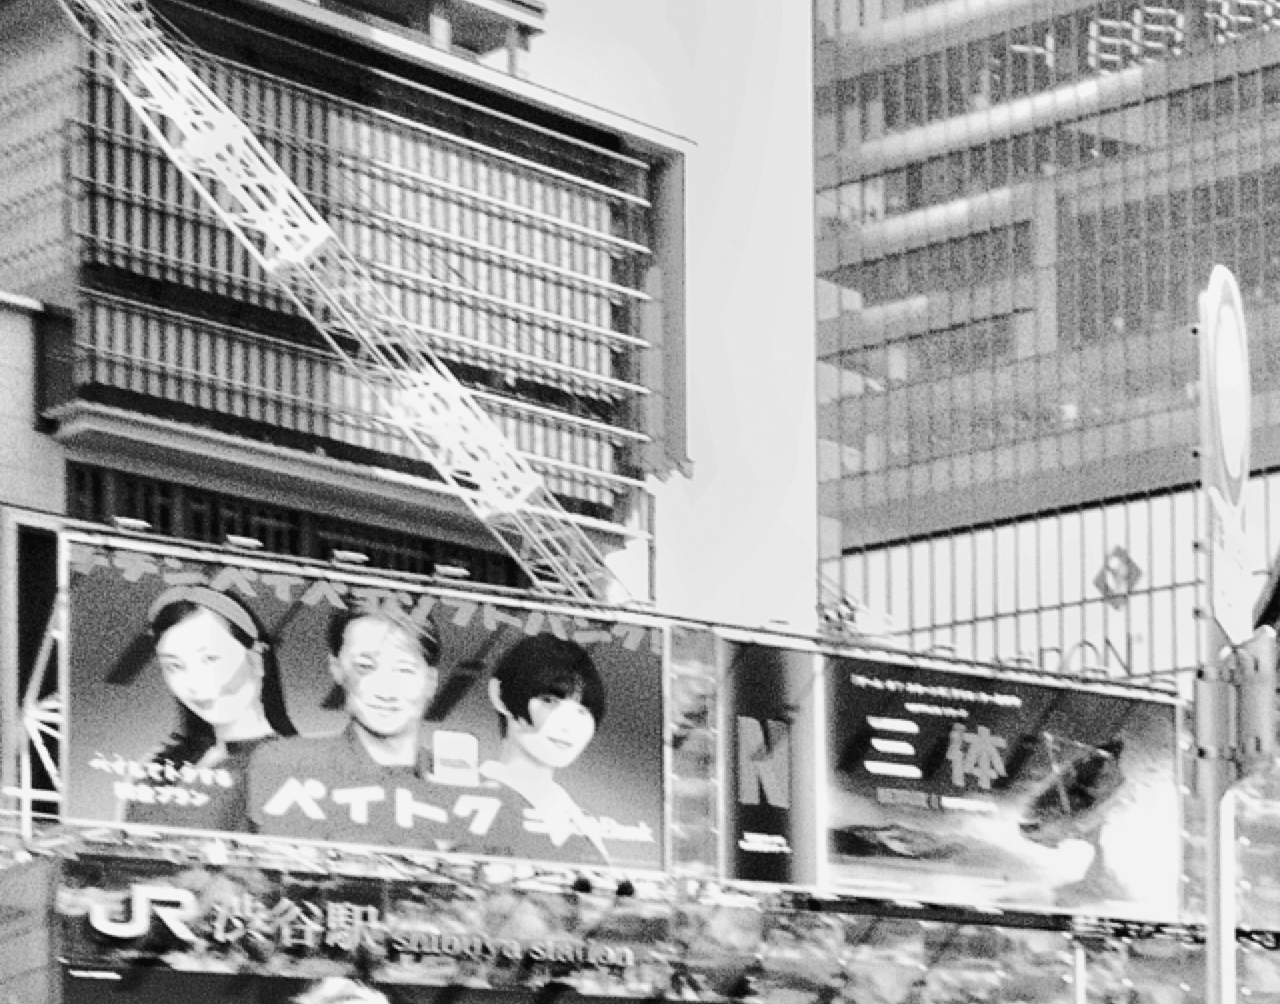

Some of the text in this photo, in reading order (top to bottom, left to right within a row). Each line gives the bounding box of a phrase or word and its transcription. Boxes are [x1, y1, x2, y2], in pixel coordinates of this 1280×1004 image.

[738, 716, 791, 809] N
[864, 714, 1008, 790] 三体
[262, 777, 502, 836] ペイトク
[89, 884, 208, 948] JR
